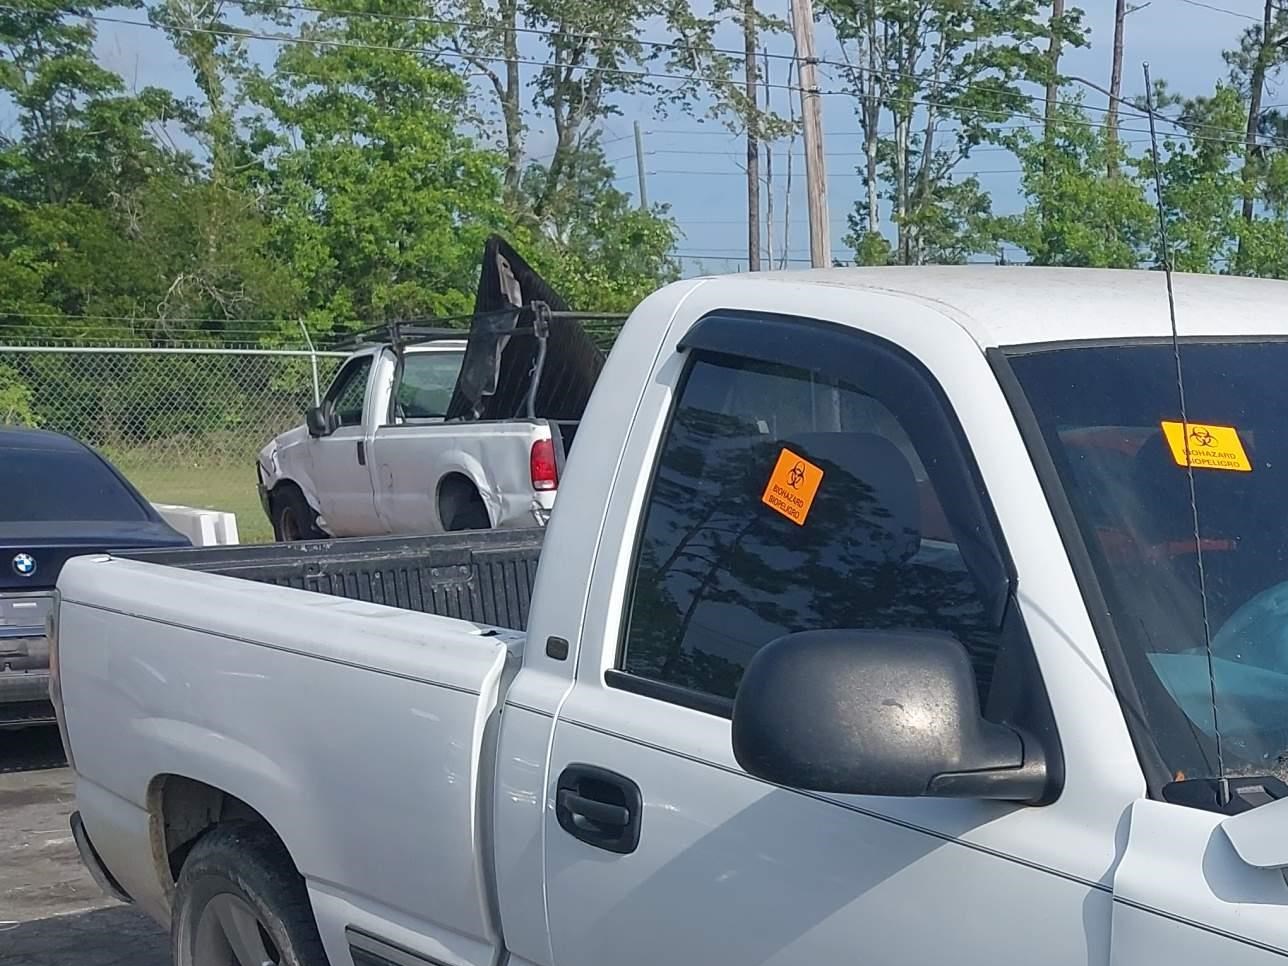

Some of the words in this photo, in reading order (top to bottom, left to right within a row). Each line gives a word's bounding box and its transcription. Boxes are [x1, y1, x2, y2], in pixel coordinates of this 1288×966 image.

[1187, 457, 1241, 468] IOPELIGRO
[768, 494, 800, 519] BIOPELIGRO
[772, 484, 804, 508] BIOHAZARD
